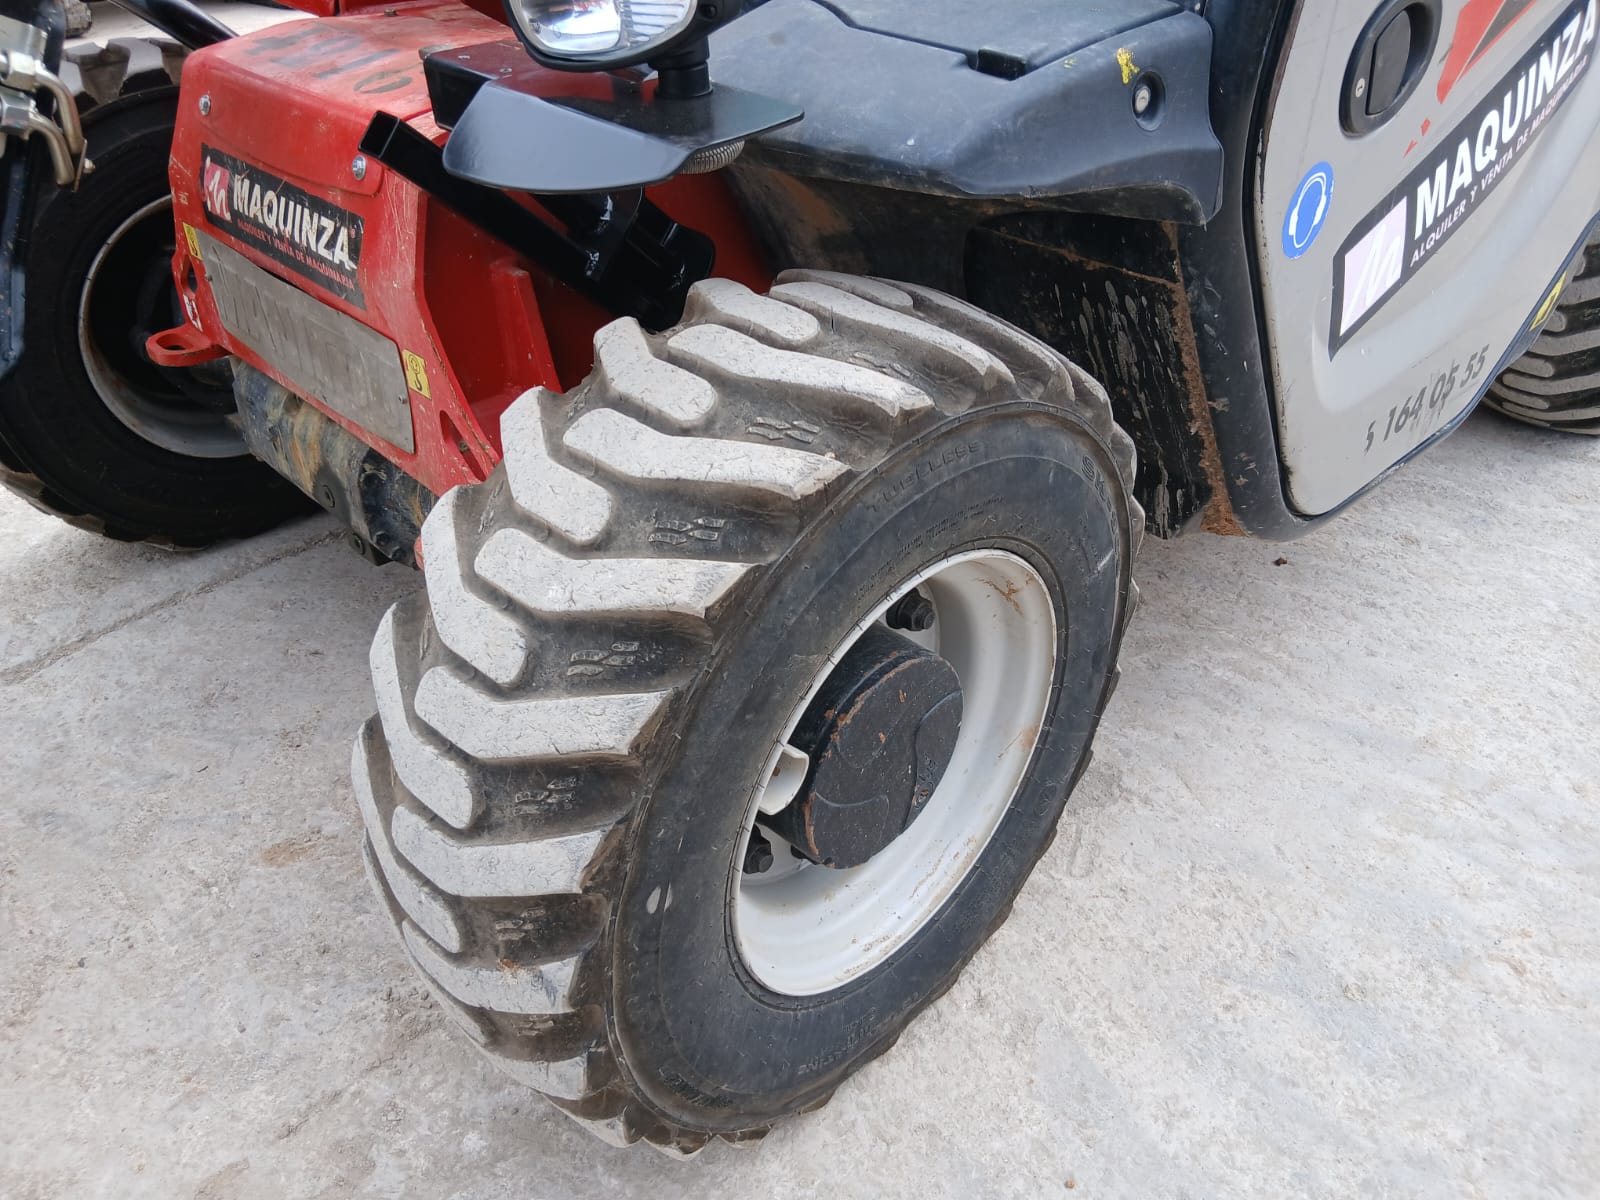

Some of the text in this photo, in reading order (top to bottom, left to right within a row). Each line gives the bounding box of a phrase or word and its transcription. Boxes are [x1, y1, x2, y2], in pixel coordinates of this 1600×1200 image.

[1414, 0, 1597, 241] MAQUINZA
[233, 173, 358, 271] MAQUINZA
[1410, 199, 1466, 268] ALQUILER
[1470, 185, 1478, 203] Y
[1481, 147, 1513, 191] VENTA
[1516, 127, 1529, 152] DE
